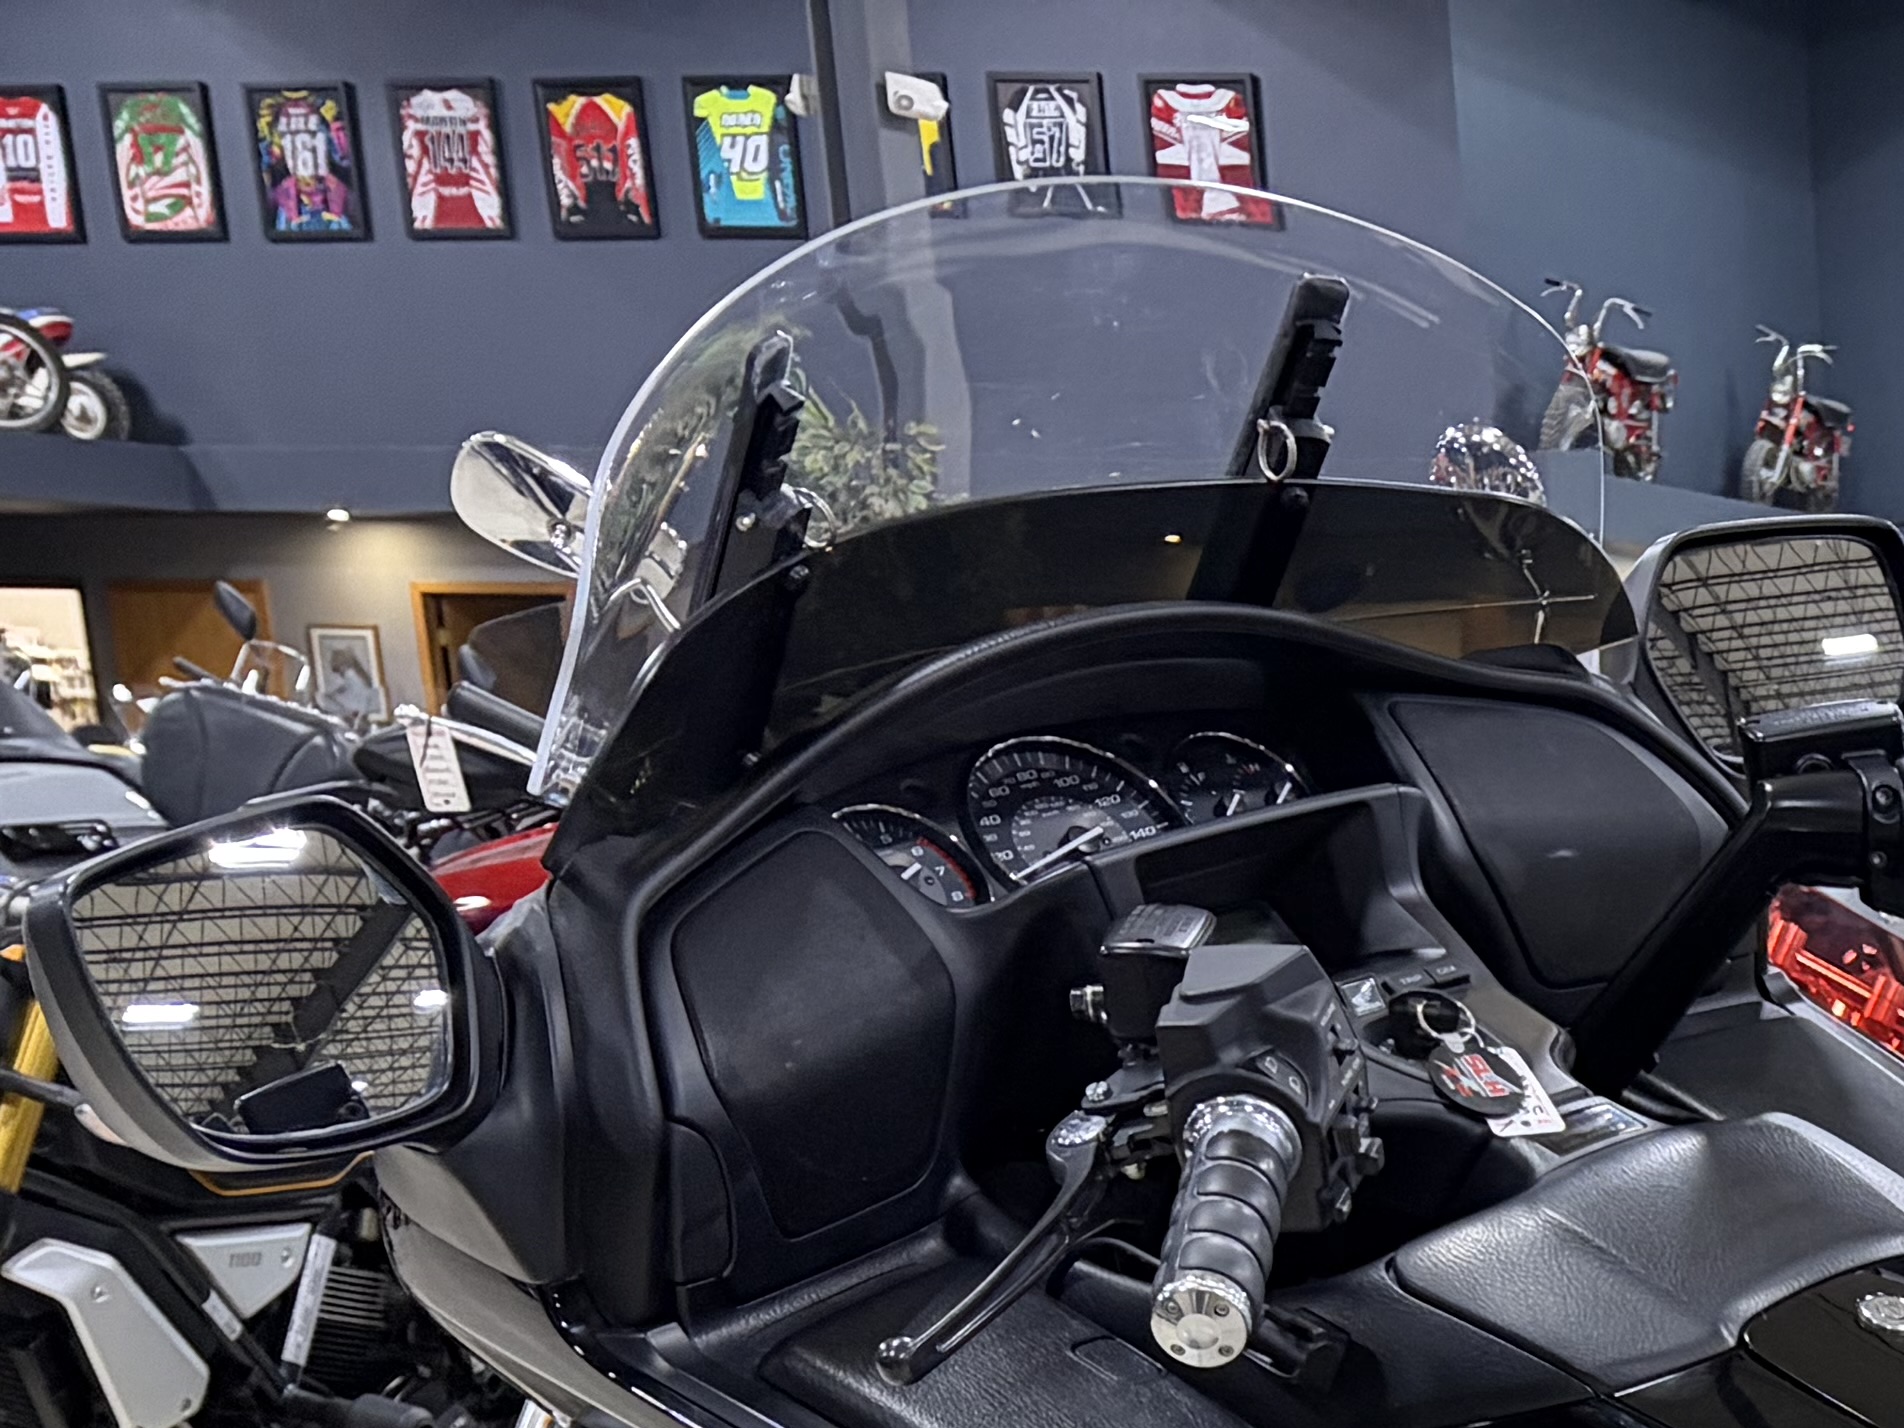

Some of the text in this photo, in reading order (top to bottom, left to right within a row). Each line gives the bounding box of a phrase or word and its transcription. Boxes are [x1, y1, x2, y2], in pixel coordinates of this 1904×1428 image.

[2, 133, 37, 168] 10
[281, 132, 329, 177] 161
[424, 129, 472, 174] 144
[719, 133, 770, 174] 40
[1053, 774, 1080, 789] 100
[1095, 794, 1121, 808] 120
[980, 814, 1001, 827] 40
[1129, 825, 1157, 840] 140
[934, 865, 945, 877] 7
